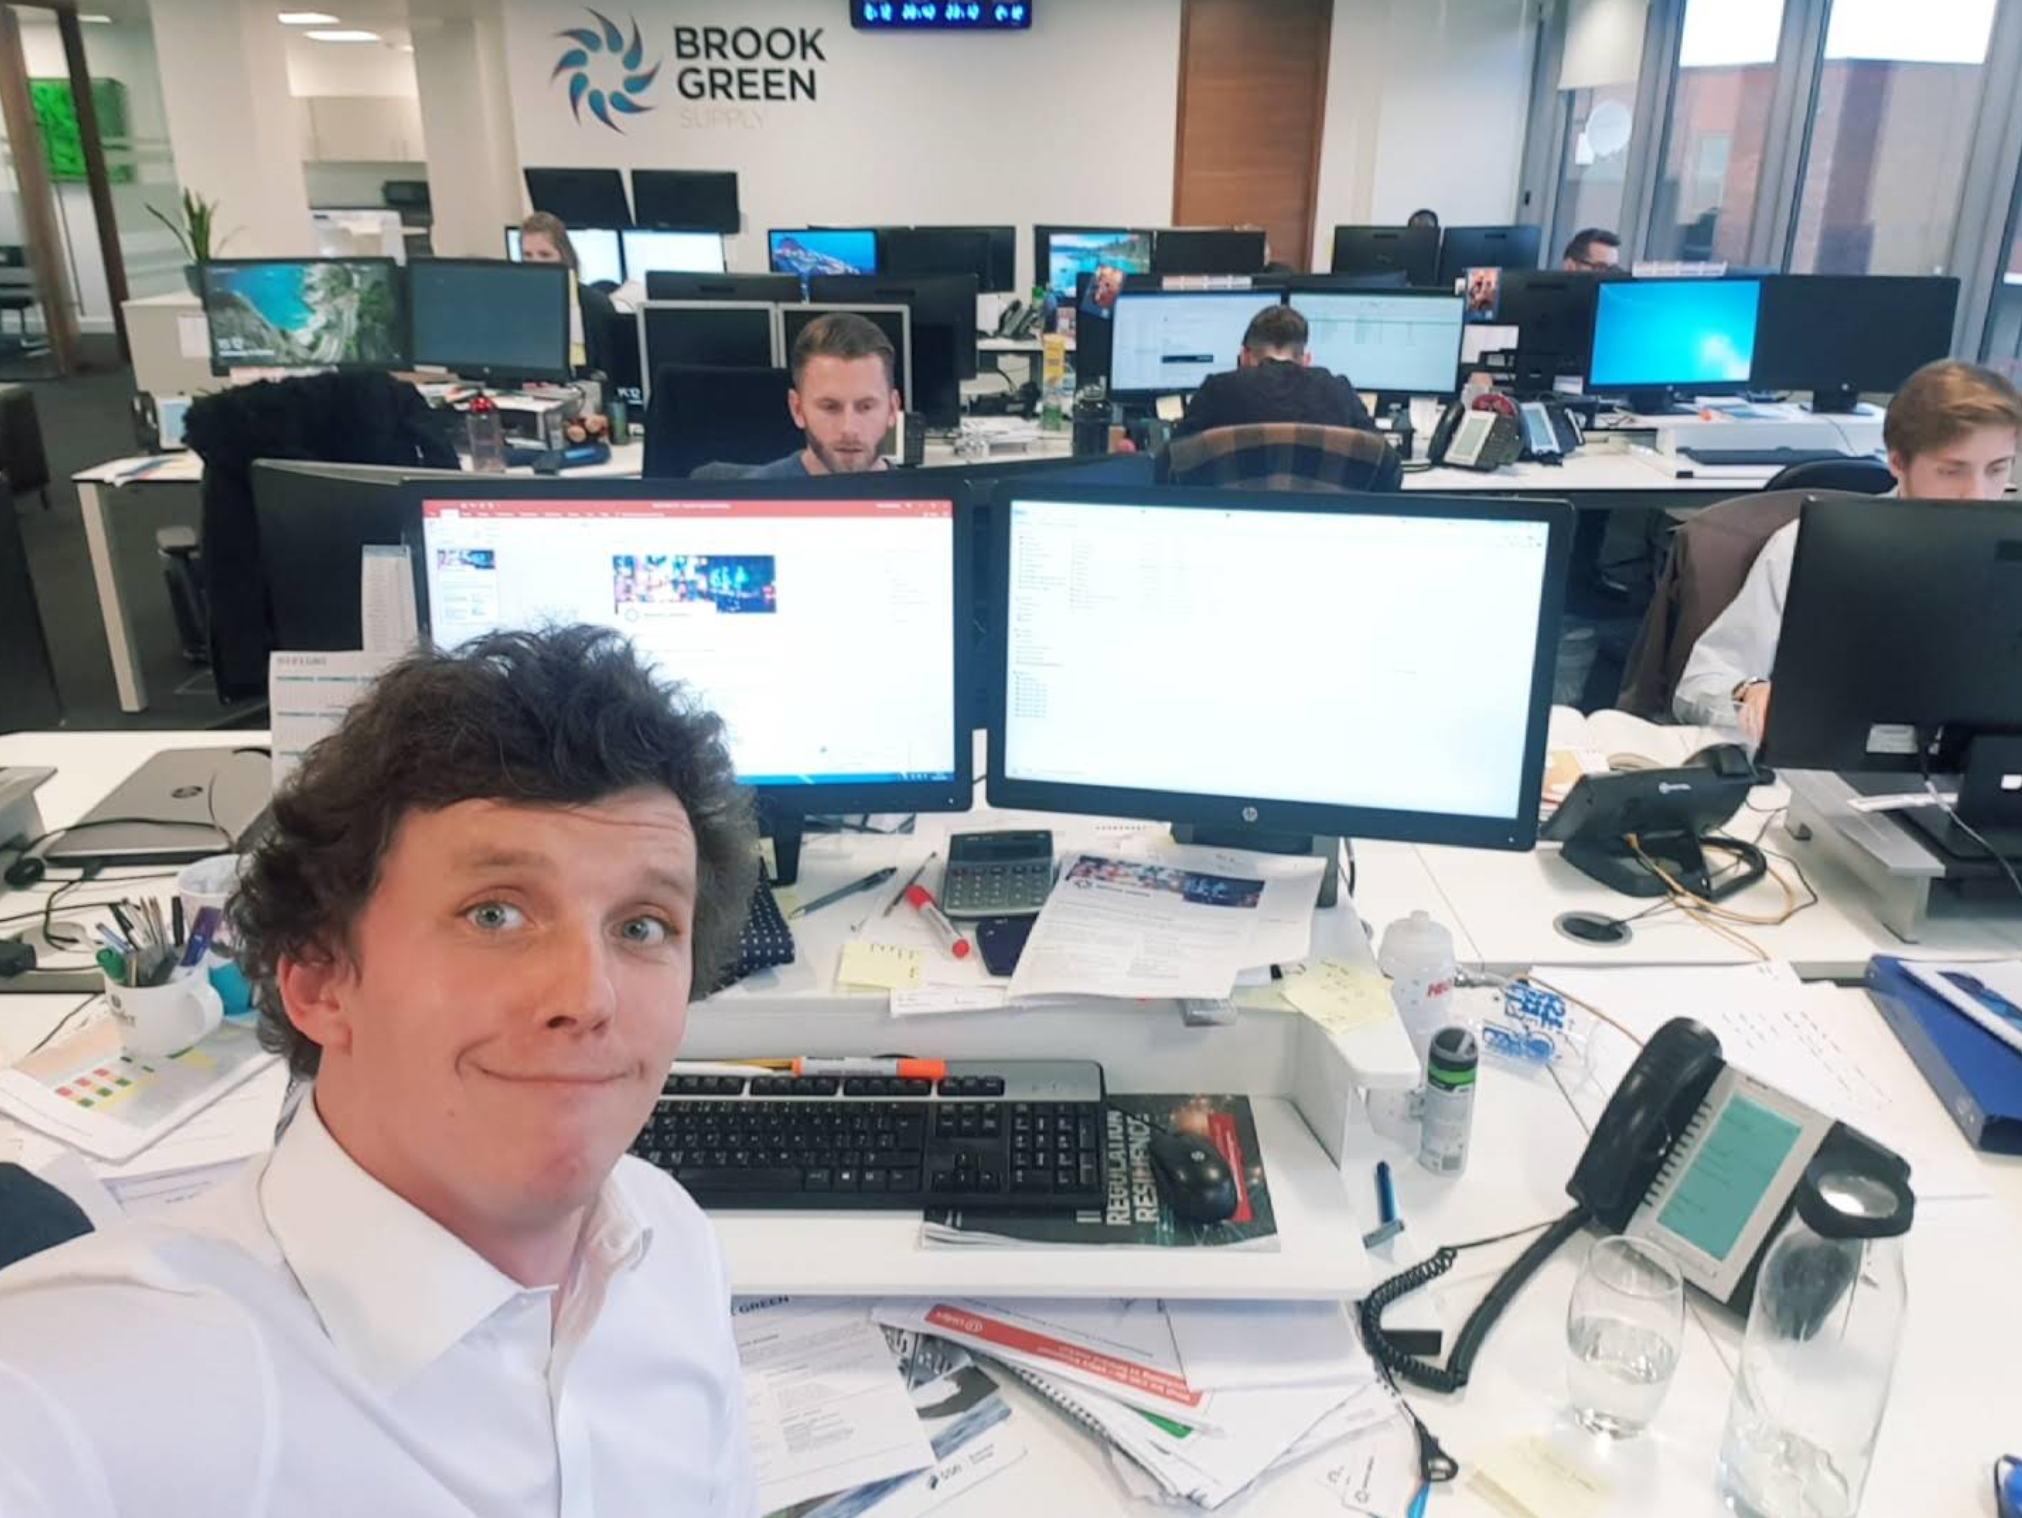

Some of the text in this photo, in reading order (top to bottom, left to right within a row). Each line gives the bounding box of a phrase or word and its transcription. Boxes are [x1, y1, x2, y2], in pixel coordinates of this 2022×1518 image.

[674, 26, 827, 61] BROOK
[677, 66, 817, 101] GREEN
[680, 107, 765, 130] SUPPLY
